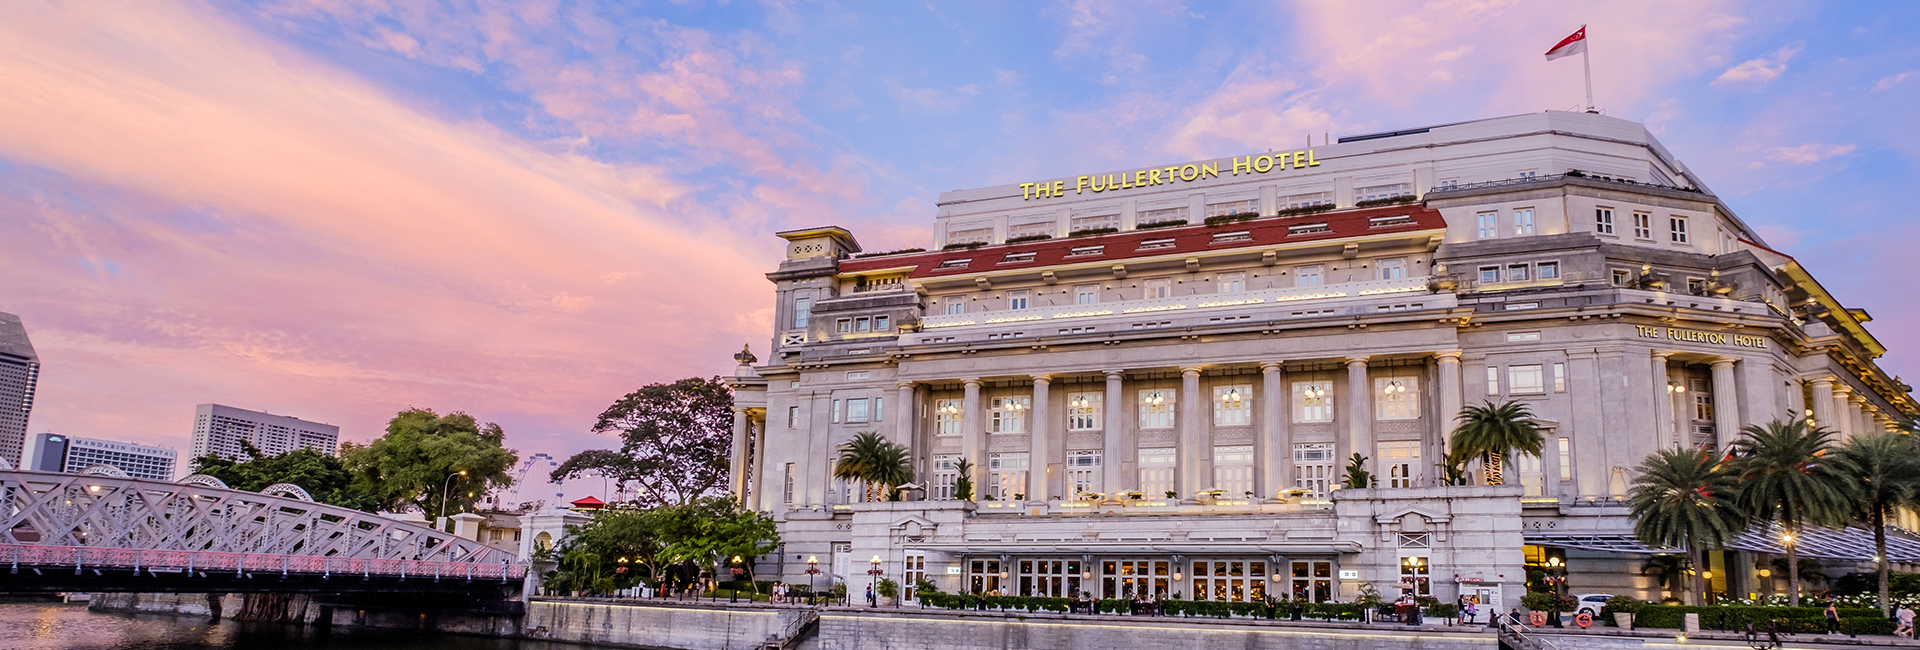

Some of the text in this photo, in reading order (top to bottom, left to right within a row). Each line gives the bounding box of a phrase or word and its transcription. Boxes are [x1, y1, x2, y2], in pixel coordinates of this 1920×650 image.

[1019, 149, 1321, 200] THE FULLERTON HOTEL
[1635, 324, 1768, 348] THE FULLERTON HOTEL
[75, 439, 175, 457] MANDARIN ORIENTAL
